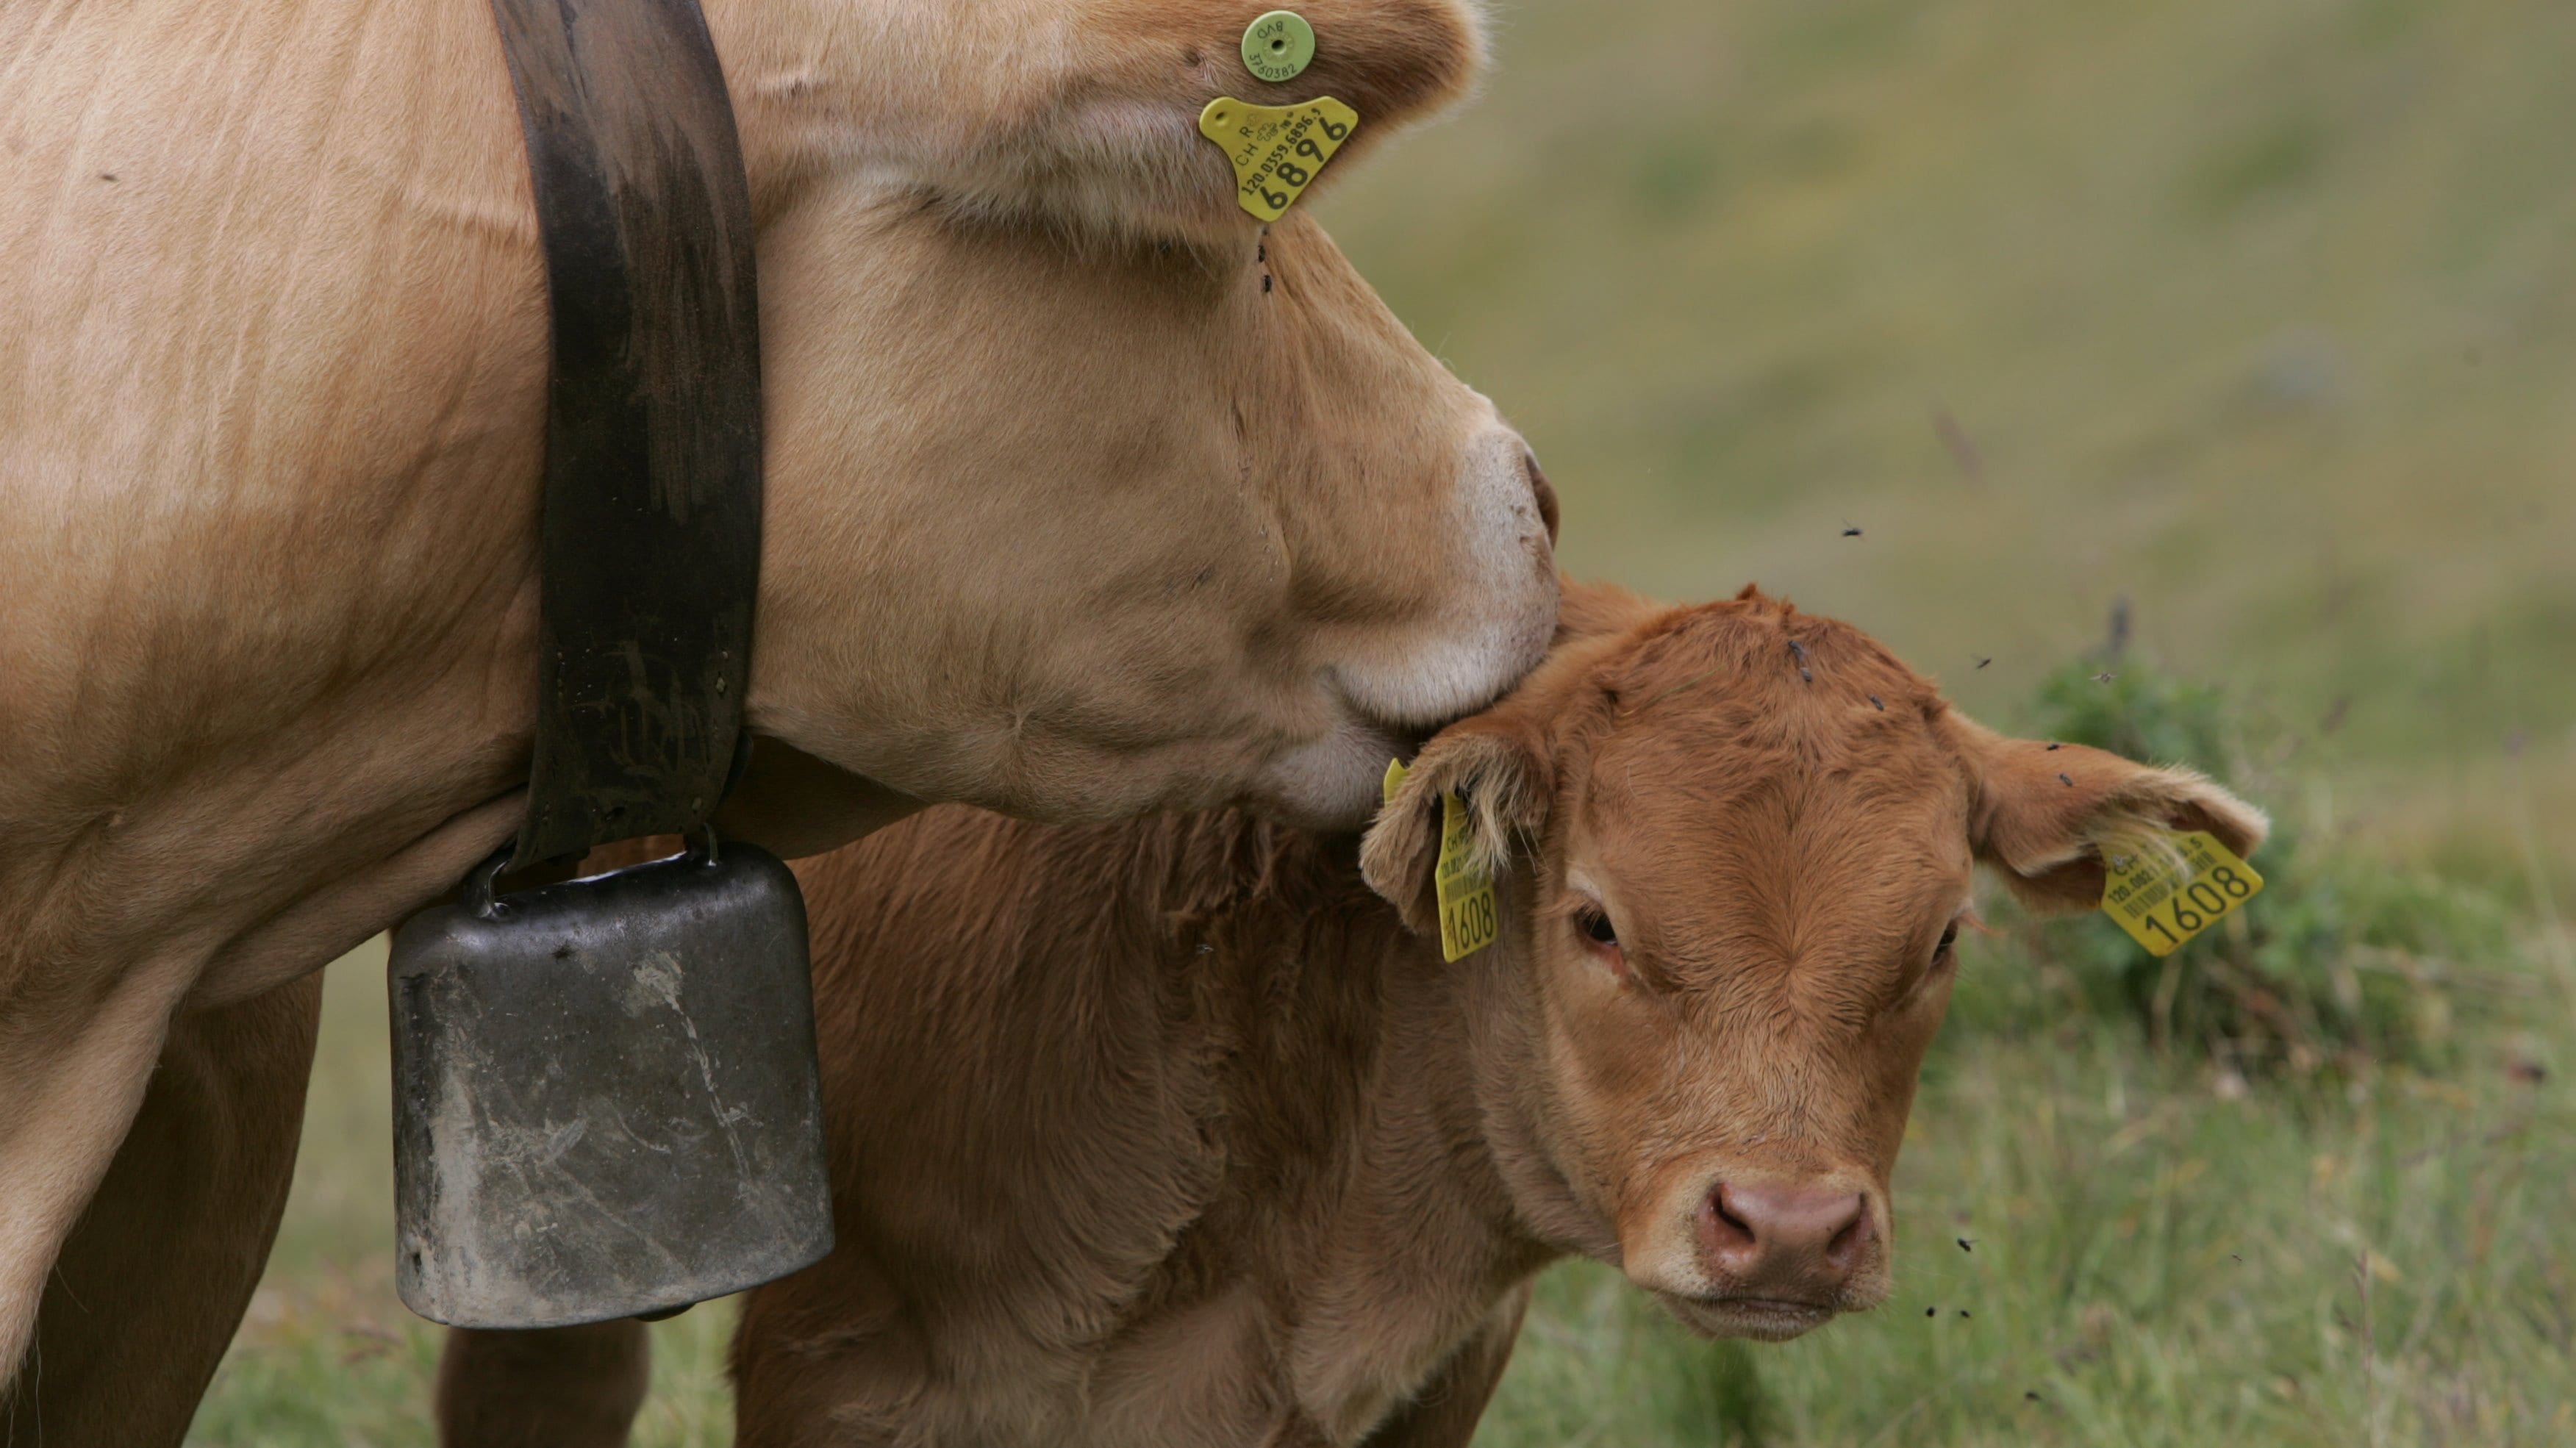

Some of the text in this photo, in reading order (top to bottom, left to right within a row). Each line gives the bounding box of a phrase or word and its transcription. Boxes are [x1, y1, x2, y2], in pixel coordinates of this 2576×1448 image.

[1257, 21, 1284, 39] BVD
[1239, 126, 1254, 138] R
[1235, 143, 1259, 166] CH
[1259, 117, 1348, 210] 6896
[1448, 891, 1494, 955] 1608
[2144, 865, 2251, 945] 1608
